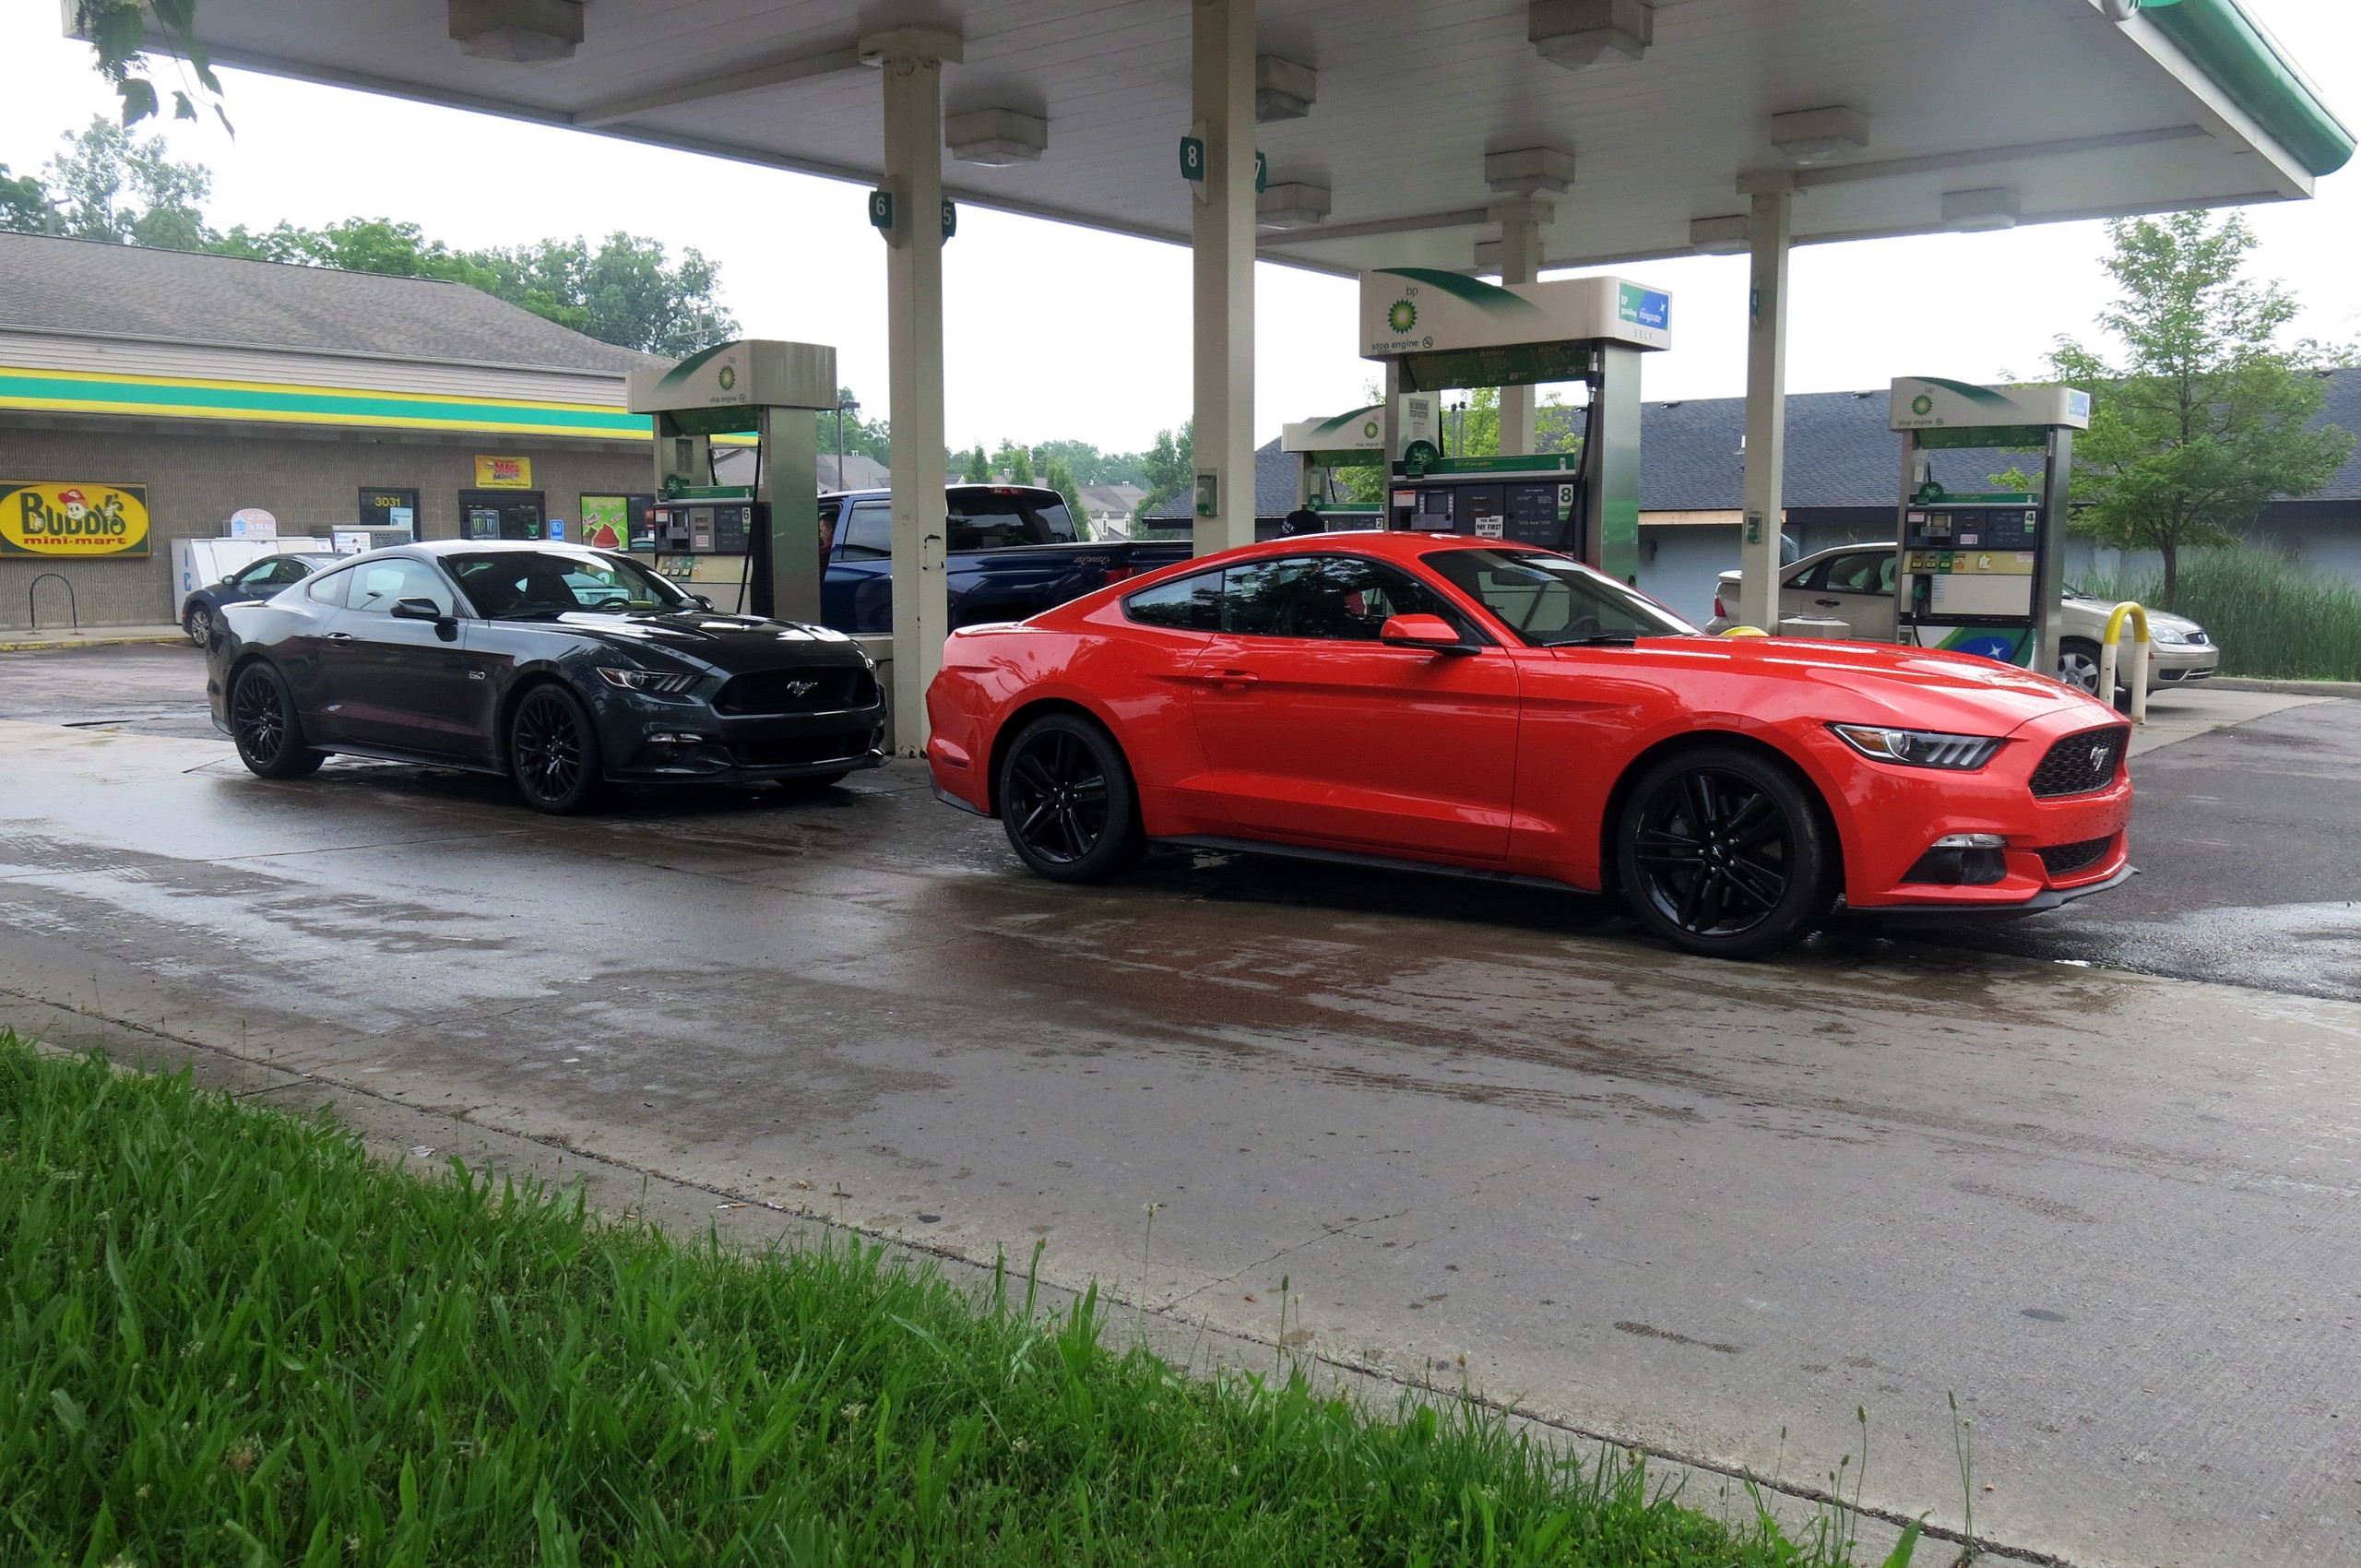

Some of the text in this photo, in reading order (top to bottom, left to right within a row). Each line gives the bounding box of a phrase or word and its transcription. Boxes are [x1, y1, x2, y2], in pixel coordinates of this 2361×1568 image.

[1187, 145, 1197, 168] 8
[875, 196, 886, 217] 6
[943, 206, 952, 226] 5
[1406, 286, 1418, 297] bp
[1620, 294, 1629, 305] BP
[1633, 328, 1653, 340] SELF
[1371, 339, 1418, 350] stop engine
[1560, 487, 1572, 503] 8
[374, 496, 400, 507] 3031
[742, 509, 750, 520] 6
[2025, 513, 2035, 522] 4
[1377, 518, 1382, 528] 2
[23, 536, 126, 545] mini-mart
